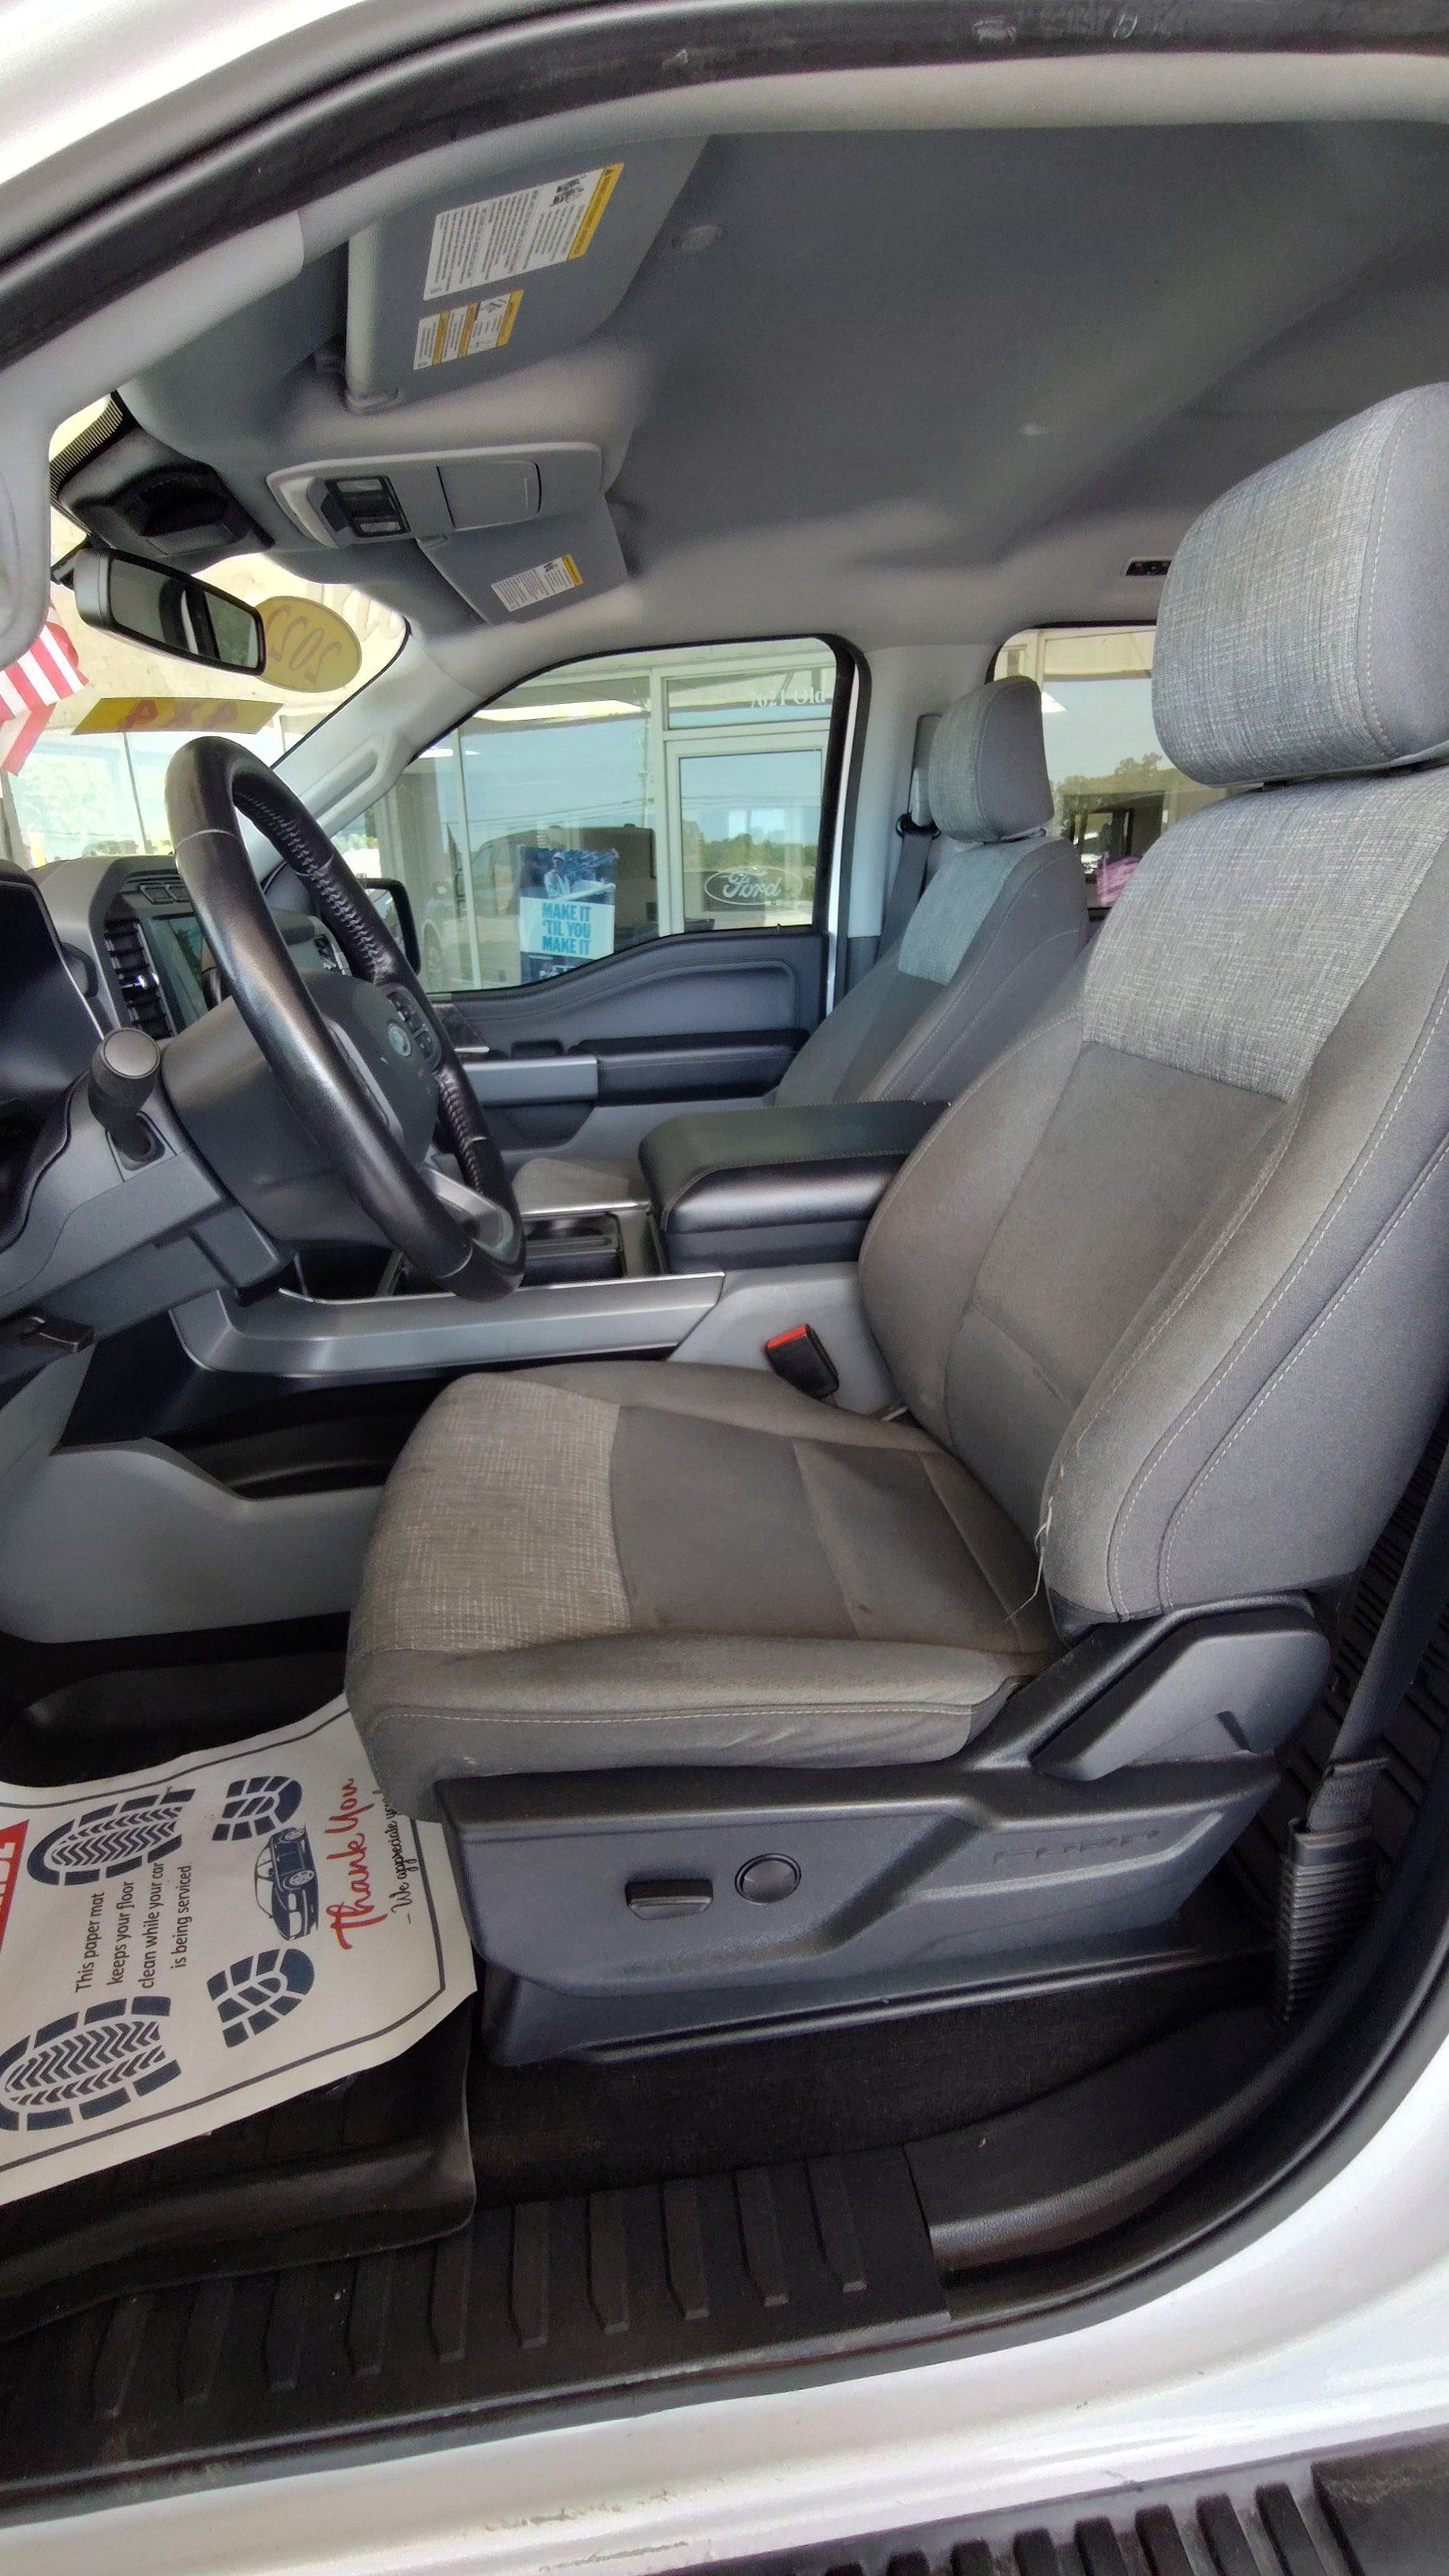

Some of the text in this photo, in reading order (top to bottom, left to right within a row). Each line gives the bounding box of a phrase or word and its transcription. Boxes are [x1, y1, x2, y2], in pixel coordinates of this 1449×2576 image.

[793, 686, 827, 705] Old
[720, 870, 784, 898] Ford
[542, 902, 592, 922] MAKE IT
[567, 922, 591, 939] YOU
[542, 935, 591, 956] MAKE IT
[324, 1778, 388, 1950] Thank You
[384, 1820, 418, 1880] appreciate
[170, 1865, 192, 1969] is being serviced
[388, 1881, 414, 1913] We
[75, 1892, 105, 1993] This paper mat
[107, 1881, 135, 1985] keeps your floor
[138, 1863, 164, 1989] clean while your car
